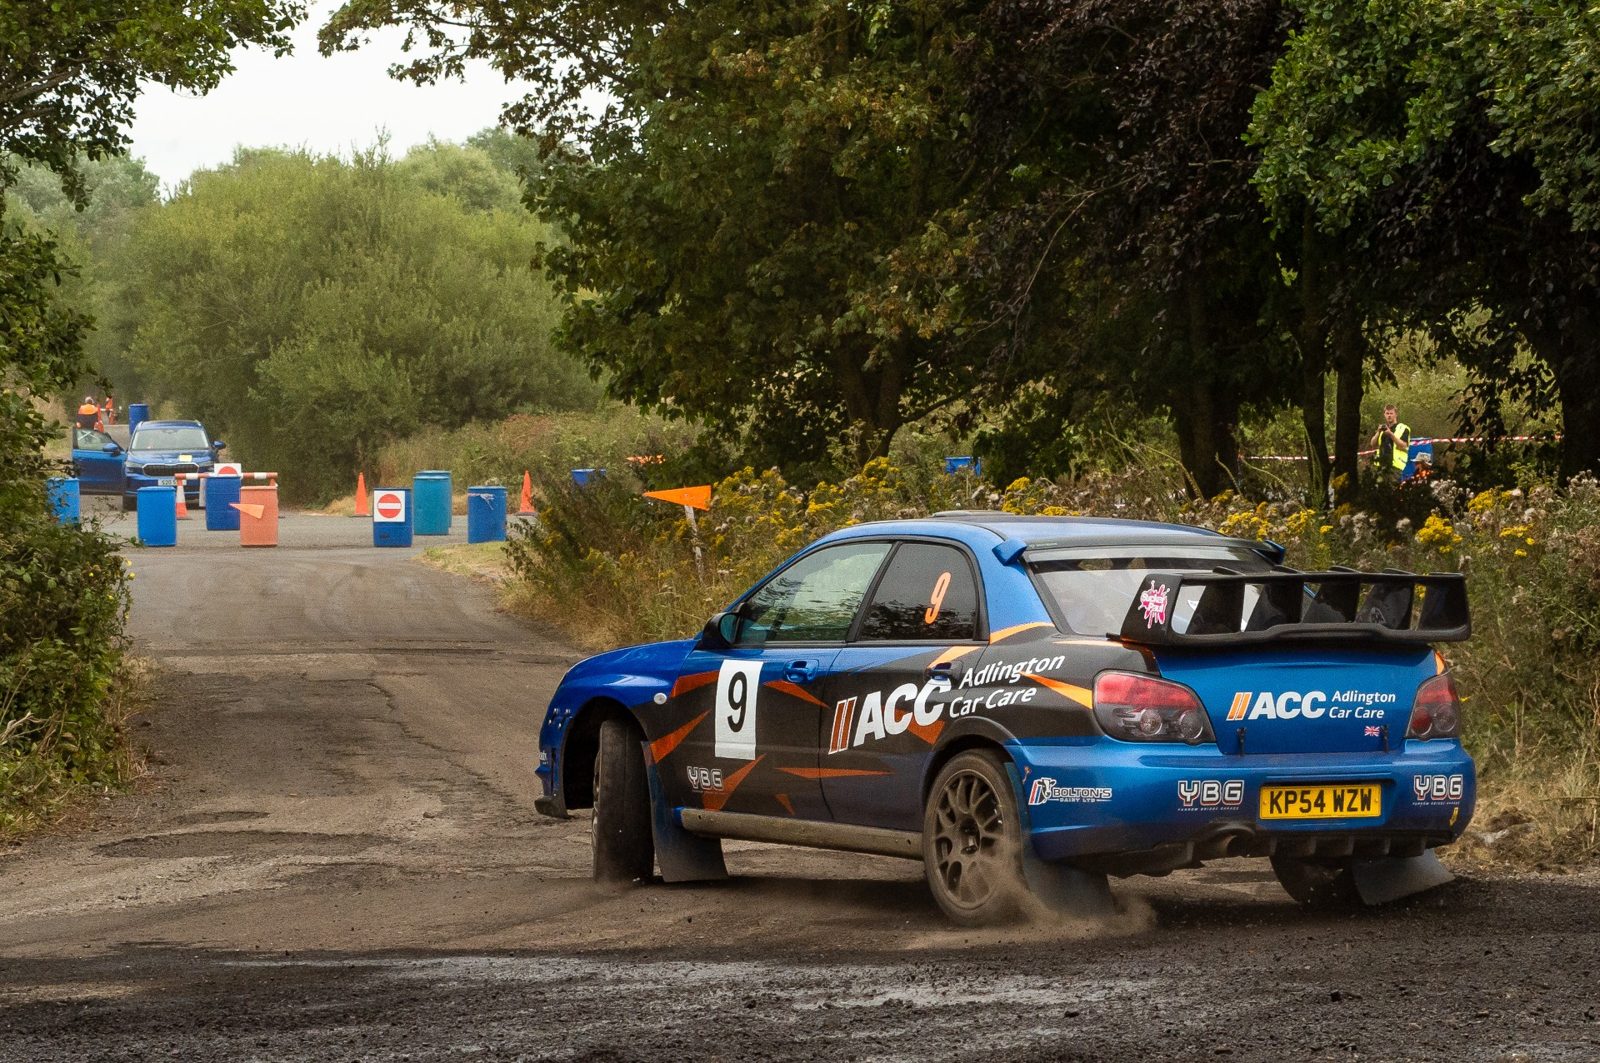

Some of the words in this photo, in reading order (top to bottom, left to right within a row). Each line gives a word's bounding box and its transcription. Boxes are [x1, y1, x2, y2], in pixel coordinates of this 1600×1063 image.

[925, 572, 951, 624] 9
[959, 655, 1066, 689] Adlington
[727, 671, 748, 733] 9
[950, 696, 984, 718] Car
[985, 687, 1037, 709] Care
[1248, 691, 1327, 719] ACC
[1332, 690, 1396, 705] Adlington
[853, 678, 952, 747] ACC
[1329, 707, 1352, 719] Car
[1354, 707, 1385, 719] Care
[687, 766, 724, 791] YBG
[1414, 774, 1463, 801] YBG
[1052, 787, 1113, 799] BOLTON'S
[1178, 780, 1245, 807] YBG
[1269, 790, 1326, 814] KP54
[1333, 788, 1372, 813] WZW
